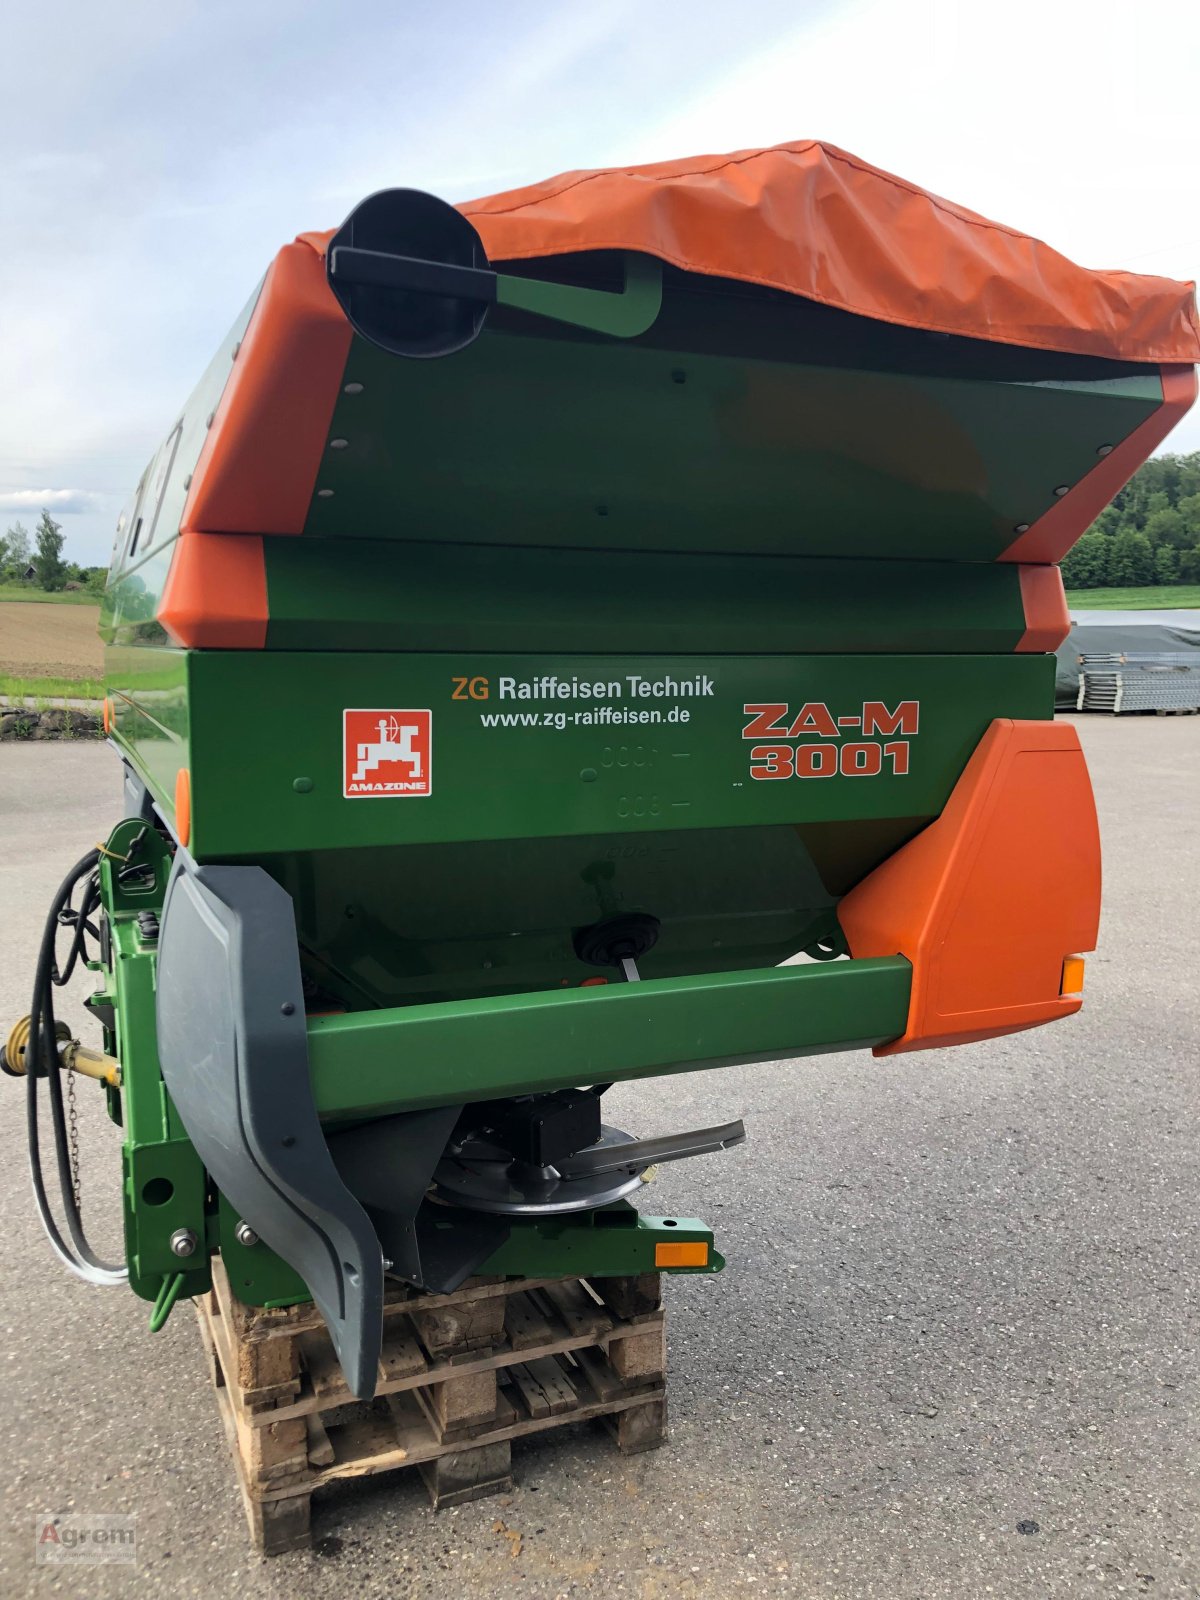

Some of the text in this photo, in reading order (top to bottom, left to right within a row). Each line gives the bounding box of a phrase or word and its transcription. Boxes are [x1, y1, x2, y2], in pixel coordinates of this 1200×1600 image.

[451, 674, 715, 700] ZG Raiffeisen Technik
[480, 705, 691, 730] www.zg-raiffeisen.de
[742, 701, 920, 739] ZA-M
[750, 741, 910, 780] 3001
[348, 781, 427, 792] AMAZONE
